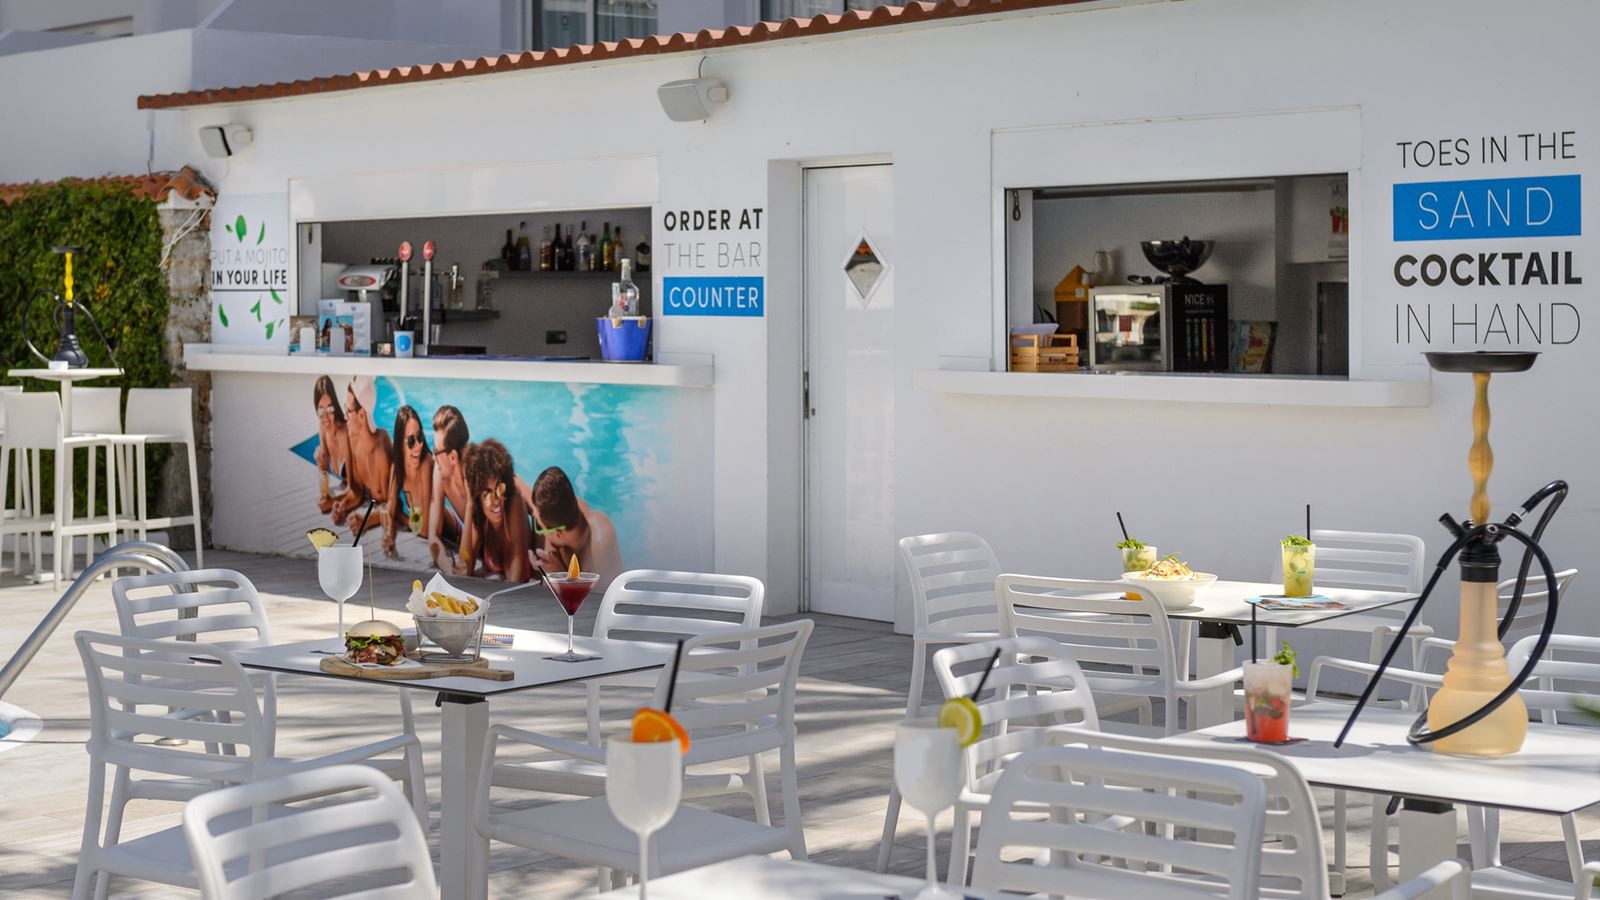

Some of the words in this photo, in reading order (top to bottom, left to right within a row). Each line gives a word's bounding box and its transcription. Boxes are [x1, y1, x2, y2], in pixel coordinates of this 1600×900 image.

[1396, 138, 1470, 168] TOES
[1482, 135, 1507, 164] IN
[1518, 131, 1576, 161] THE
[664, 209, 731, 232] ORDER
[739, 208, 763, 230] AT
[1418, 186, 1553, 230] SAND
[212, 248, 231, 265] PUT
[234, 249, 241, 264] A
[245, 247, 287, 268] MOJITO
[664, 242, 705, 268] THE
[718, 242, 761, 268] BAR
[212, 270, 223, 285] IN
[227, 269, 258, 285] YOUR
[263, 269, 287, 285] LIFE
[1394, 251, 1582, 287] COCKTAIL
[669, 286, 759, 309] COUNTER
[1396, 303, 1431, 344] IN
[1452, 302, 1581, 345] HAND
